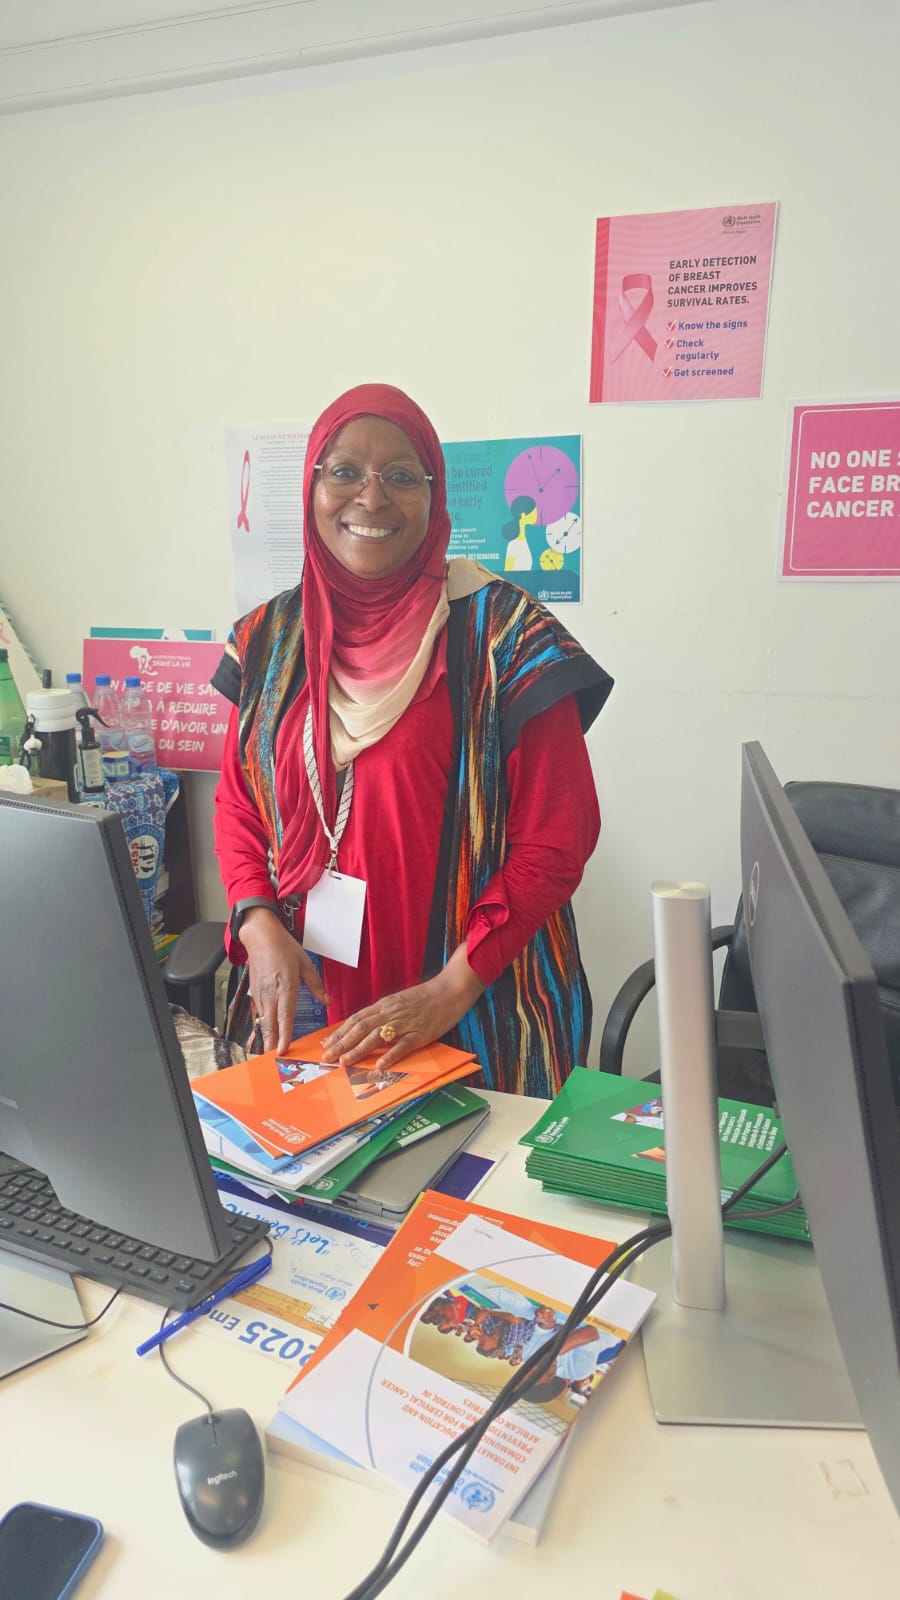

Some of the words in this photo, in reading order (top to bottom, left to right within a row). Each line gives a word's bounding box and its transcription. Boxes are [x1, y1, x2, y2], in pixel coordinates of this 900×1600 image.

[670, 260, 700, 269] EARLY
[702, 256, 757, 267] DETECTION
[668, 272, 680, 282] OF
[683, 271, 721, 281] BREAST
[668, 284, 706, 295] CANCER
[708, 282, 757, 292] IMPROVES
[667, 297, 713, 308] SURVIVAL
[716, 296, 750, 306] RATES.
[678, 322, 704, 331] Know
[706, 321, 721, 329] the
[723, 320, 748, 331] signs
[676, 339, 704, 348] Check
[675, 351, 719, 362] regularly
[674, 368, 689, 377] Get
[692, 367, 734, 376] screened
[810, 451, 840, 469] NO
[847, 450, 892, 468] ONE
[452, 465, 463, 478] be
[465, 464, 492, 478] cured
[808, 476, 865, 494] FACE
[871, 474, 900, 492] BR
[806, 500, 894, 518] CANCER
[110, 680, 119, 690] N
[157, 682, 173, 693] DE
[176, 682, 195, 694] VIE
[161, 719, 208, 735] D'AVOIR
[211, 723, 228, 735] UN
[158, 739, 174, 751] DU
[178, 740, 204, 752] SEIN
[439, 1223, 454, 1232] and
[429, 1236, 442, 1244] ive
[408, 1251, 426, 1261] ness
[407, 1258, 421, 1268] city
[380, 1378, 410, 1398] CANCER
[422, 1389, 433, 1399] IN
[402, 1404, 418, 1417] AND
[409, 1394, 444, 1418] CERVICAL
[433, 1394, 466, 1417] CONTROL
[418, 1412, 459, 1440] DUCATION
[443, 1414, 459, 1427] FOR
[504, 1420, 542, 1444] AFRICAN
[488, 1426, 533, 1454] PREVENTIO
[476, 1446, 520, 1474] INFORMAT
[208, 1470, 238, 1485] logitech
